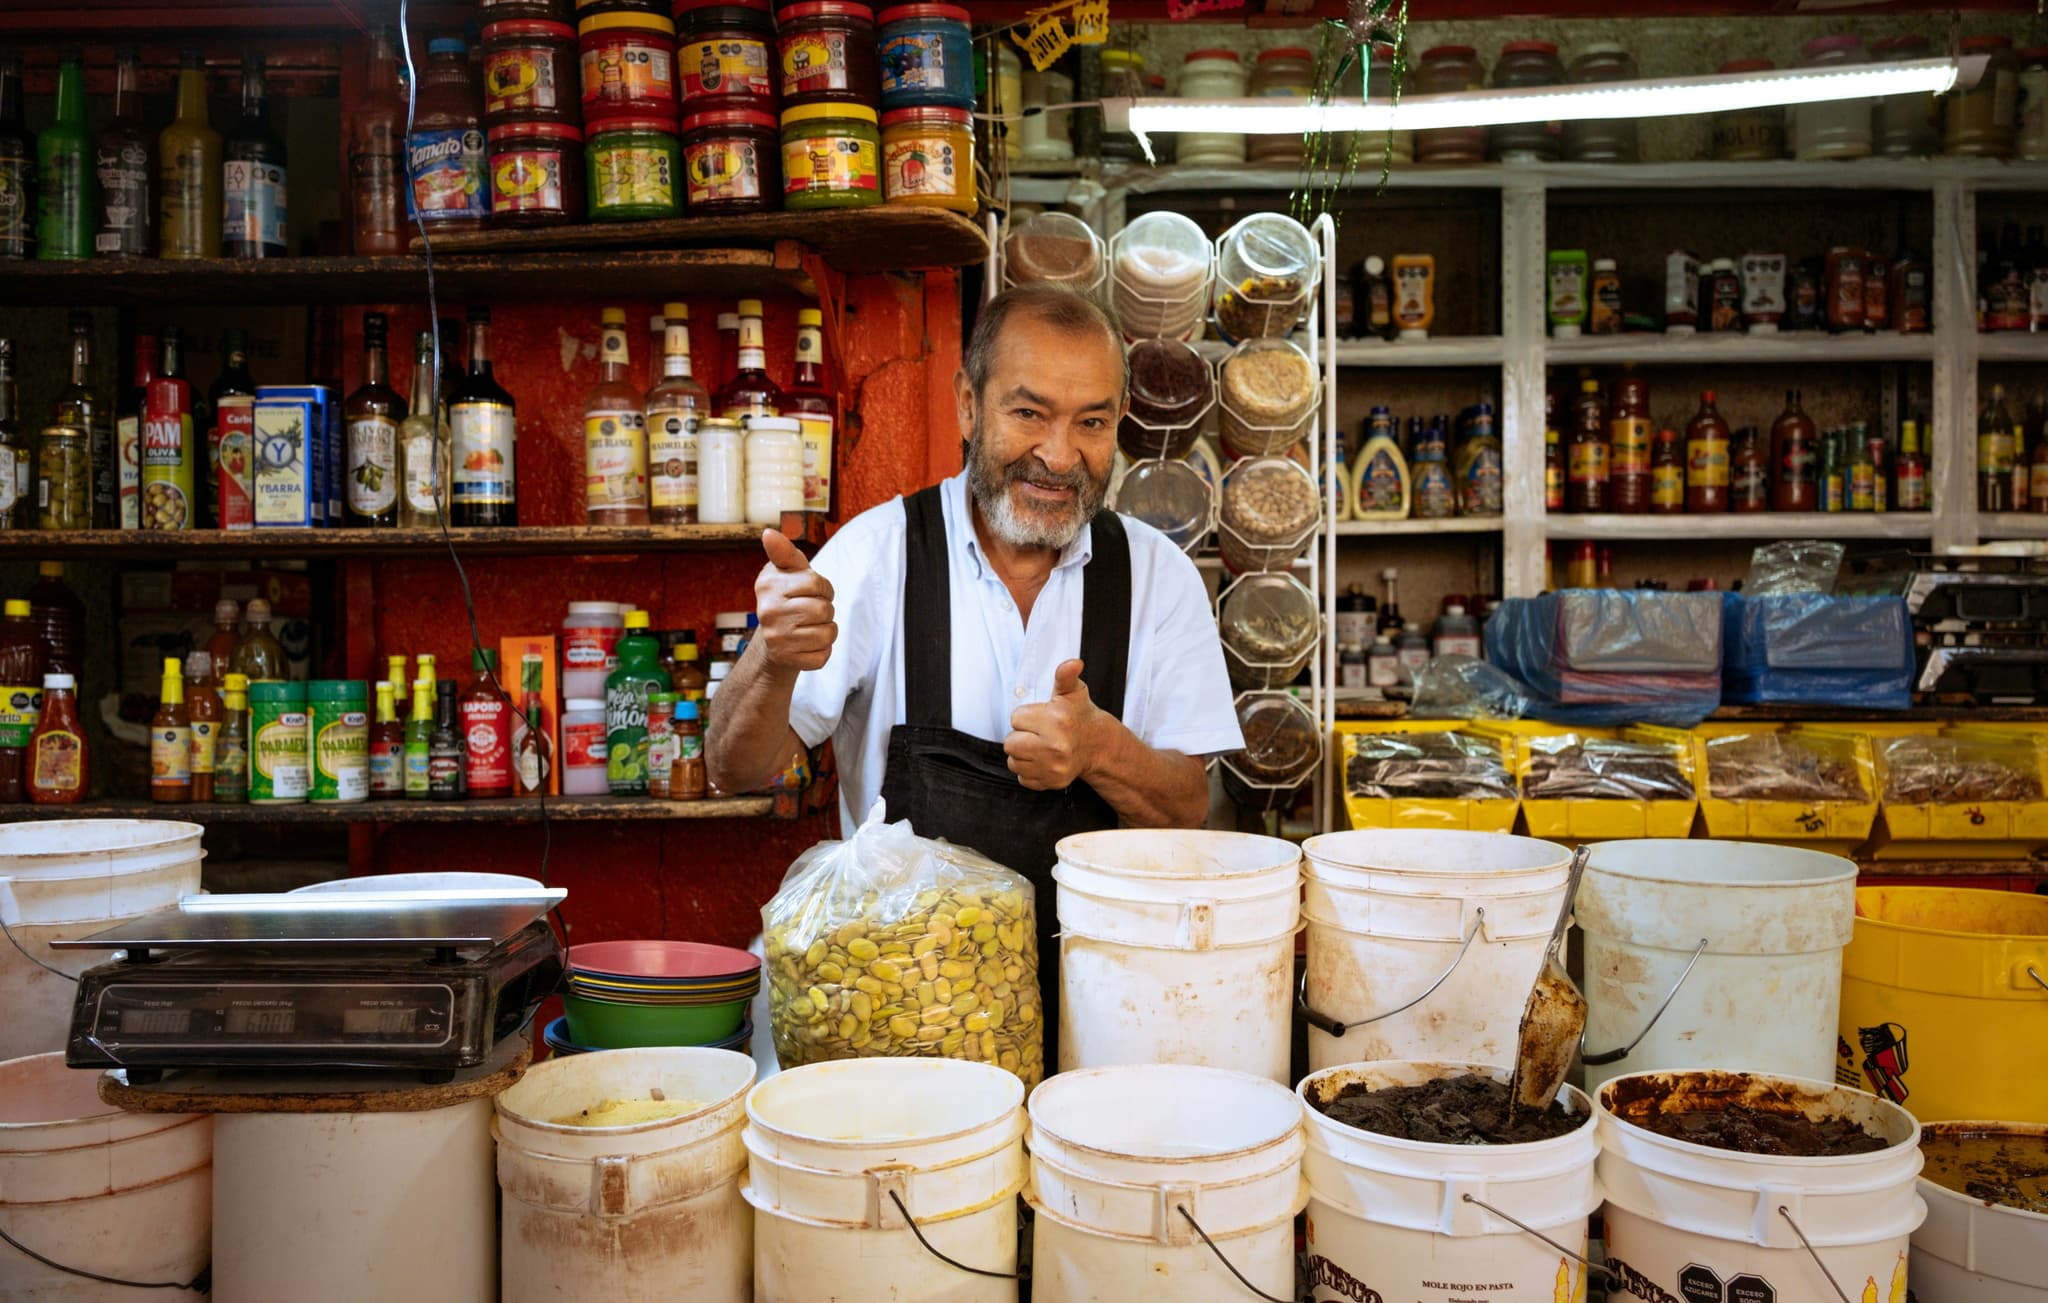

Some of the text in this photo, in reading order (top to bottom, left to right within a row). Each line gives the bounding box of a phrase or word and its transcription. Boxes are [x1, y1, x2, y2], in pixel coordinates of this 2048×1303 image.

[410, 137, 460, 169] lamato
[145, 421, 181, 447] PAM
[147, 447, 176, 457] OLIVA
[272, 442, 286, 462] Y
[258, 483, 302, 494] YBARRA
[285, 715, 305, 724] Kraft
[346, 715, 365, 723] Kraft
[1422, 1280, 1514, 1292] MOLE ROJO EN PASTA
[1687, 1278, 1714, 1290] EXCESO
[1684, 1286, 1719, 1299] AZUCARES
[1735, 1288, 1765, 1298] EXCESO
